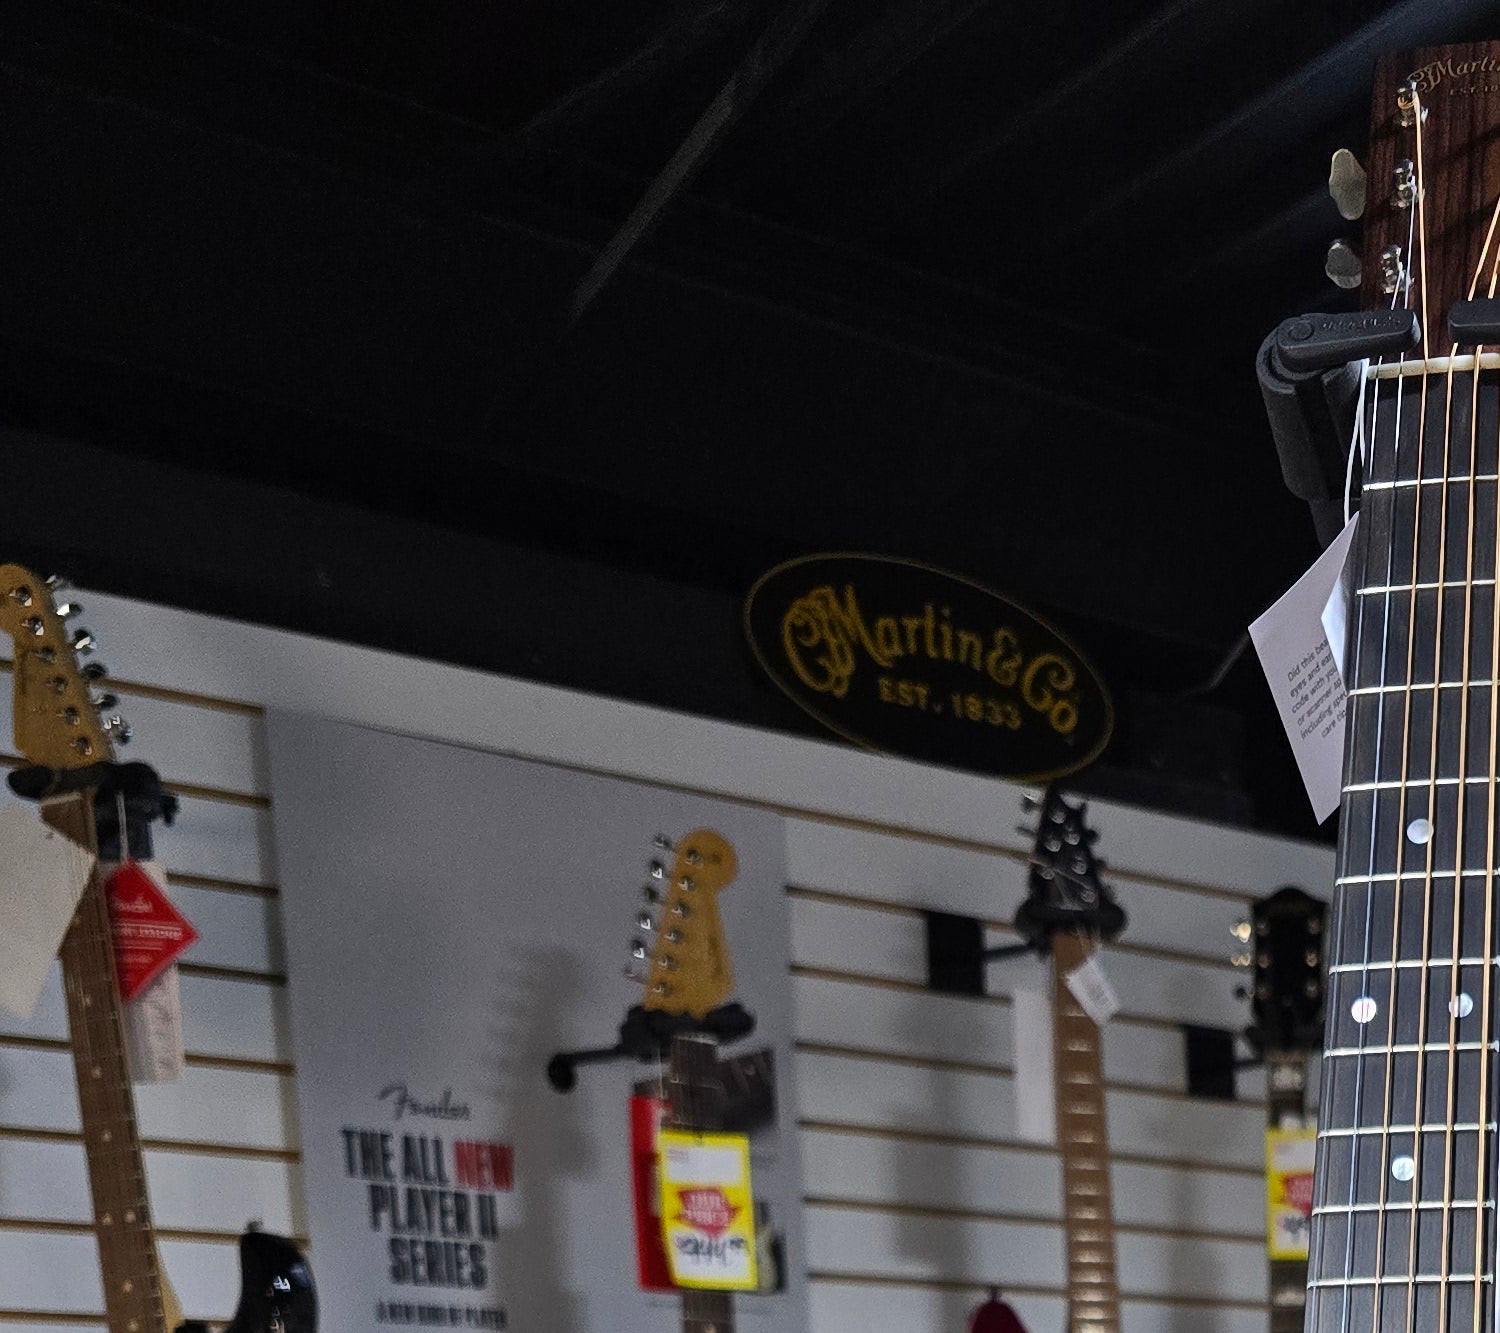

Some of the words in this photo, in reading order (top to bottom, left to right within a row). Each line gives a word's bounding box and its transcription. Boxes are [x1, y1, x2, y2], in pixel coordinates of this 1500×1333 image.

[1287, 664, 1302, 682] Did
[1300, 651, 1315, 670] this
[1315, 638, 1329, 655] bea
[1289, 677, 1307, 699] eyes
[1307, 664, 1321, 682] and
[1320, 652, 1333, 668] ear
[1291, 694, 1310, 714] code
[1309, 677, 1327, 697] with
[1326, 665, 1339, 681] you
[1297, 714, 1306, 727] or
[1306, 688, 1334, 719] scanner
[1300, 704, 1334, 741] including
[1333, 691, 1347, 710] spec
[1321, 720, 1337, 739] care
[1336, 710, 1346, 723] tip
[377, 1082, 471, 1121] Fender
[341, 1126, 394, 1181] THE
[403, 1135, 449, 1184] ALL
[453, 1138, 515, 1193] NEW
[368, 1183, 472, 1239] PLAYER
[477, 1191, 499, 1241] II
[390, 1236, 487, 1291] SERIES
